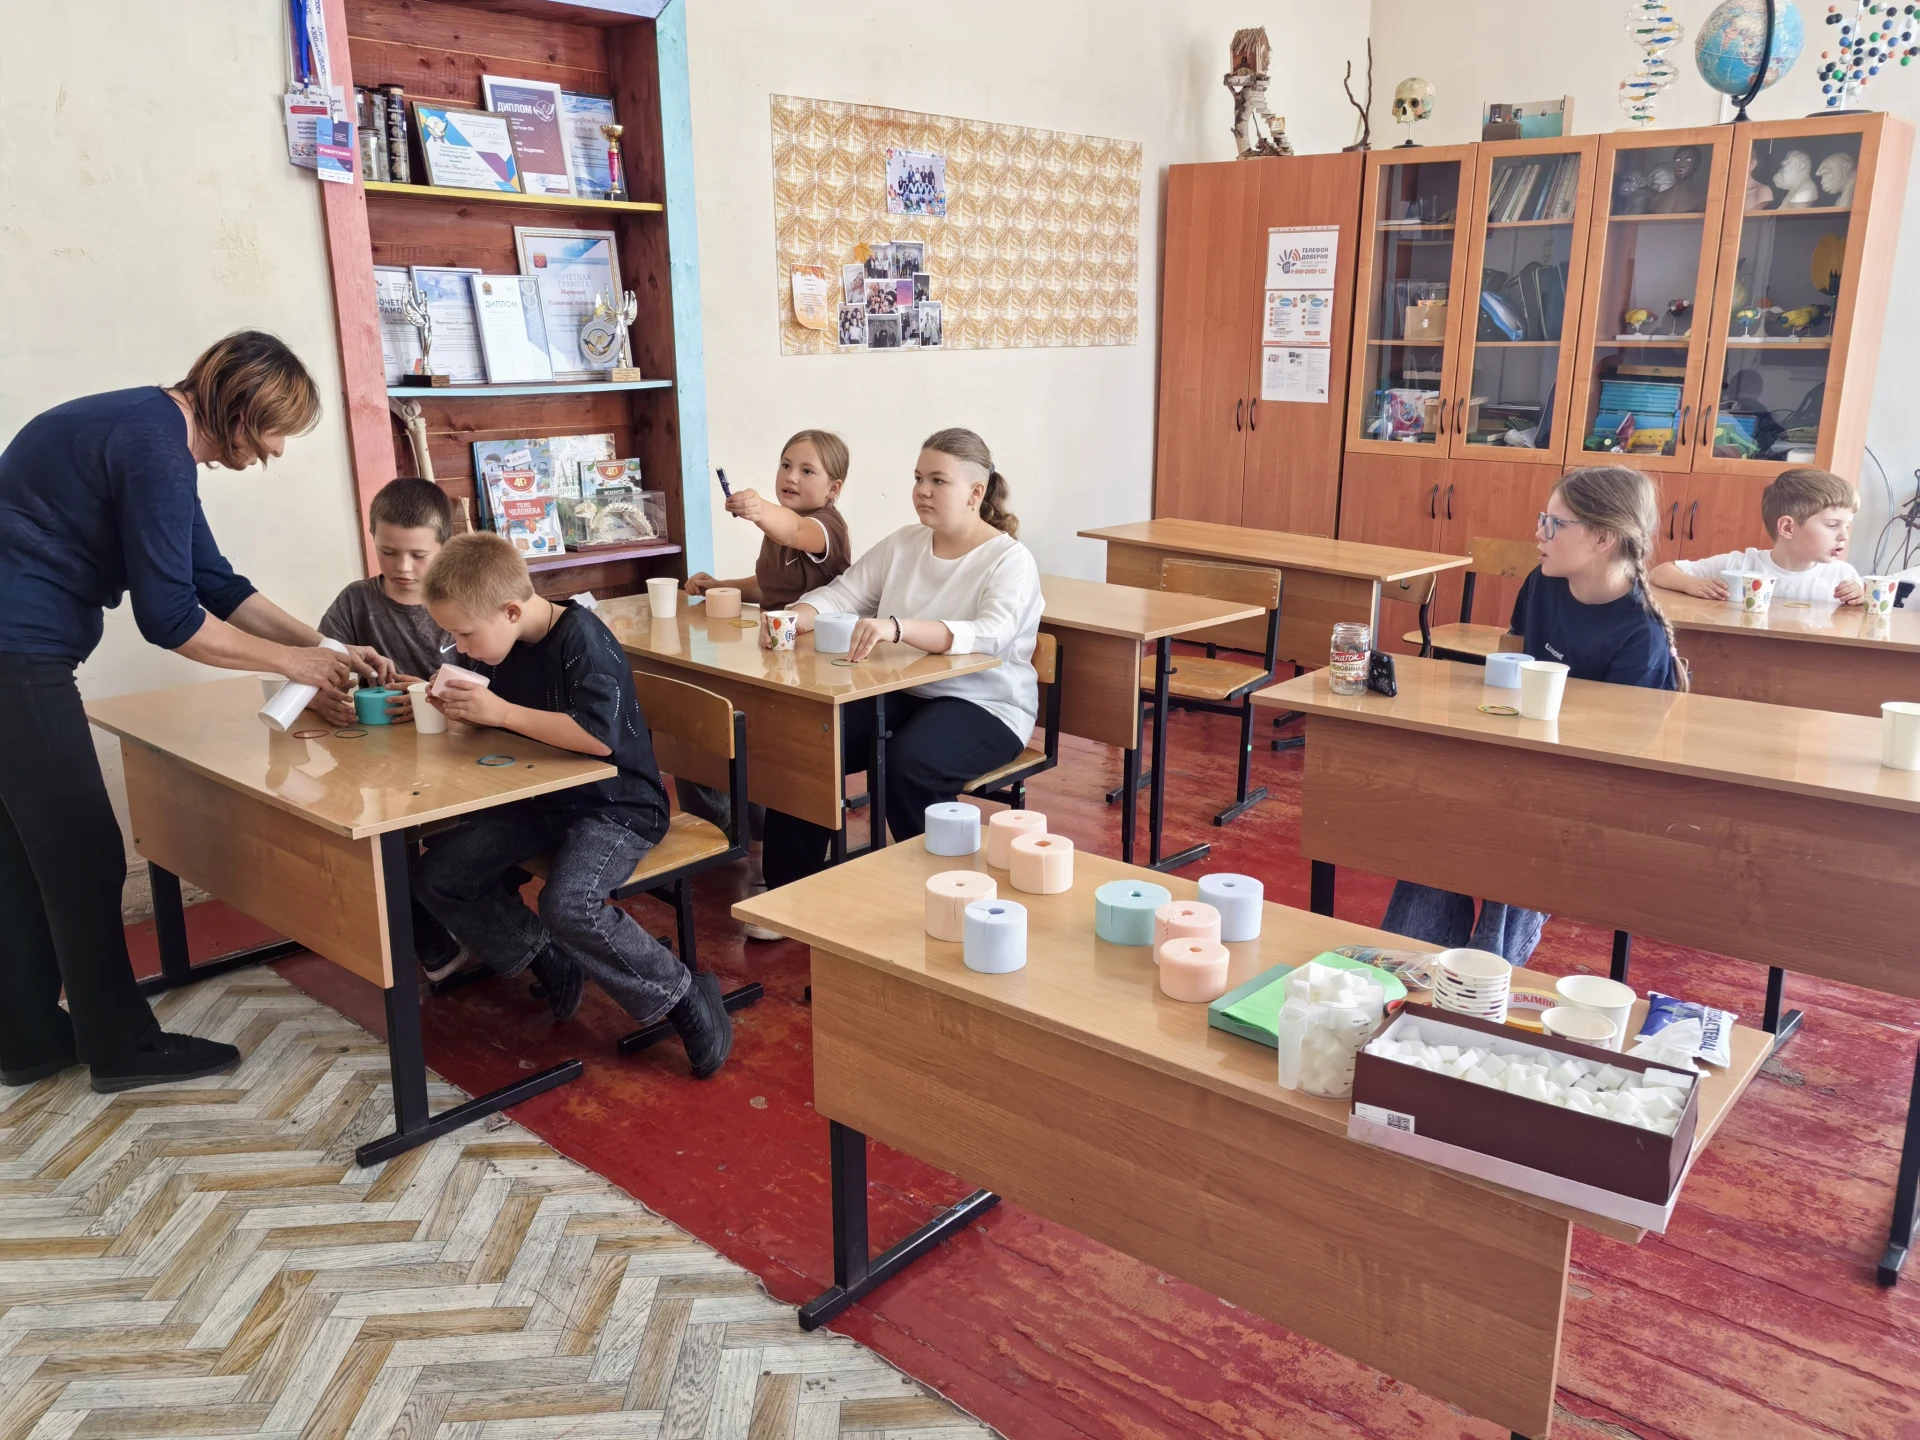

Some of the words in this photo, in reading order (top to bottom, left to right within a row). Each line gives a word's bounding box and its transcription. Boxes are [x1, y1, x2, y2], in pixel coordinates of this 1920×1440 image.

[497, 101, 532, 114] ДИПЛОМ
[472, 131, 506, 141] ДИПЛОМ
[1301, 253, 1329, 261] ДОВЕРИЯ
[554, 272, 592, 281] ПОЧЕТНАЯ
[557, 280, 591, 288] ГРАМОТА
[485, 300, 518, 308] ДИПЛОМ
[508, 507, 542, 516] ЧЕЛОВЕКА
[1331, 663, 1361, 672] РЕНОВИНА
[1522, 994, 1556, 1008] KIMBO
